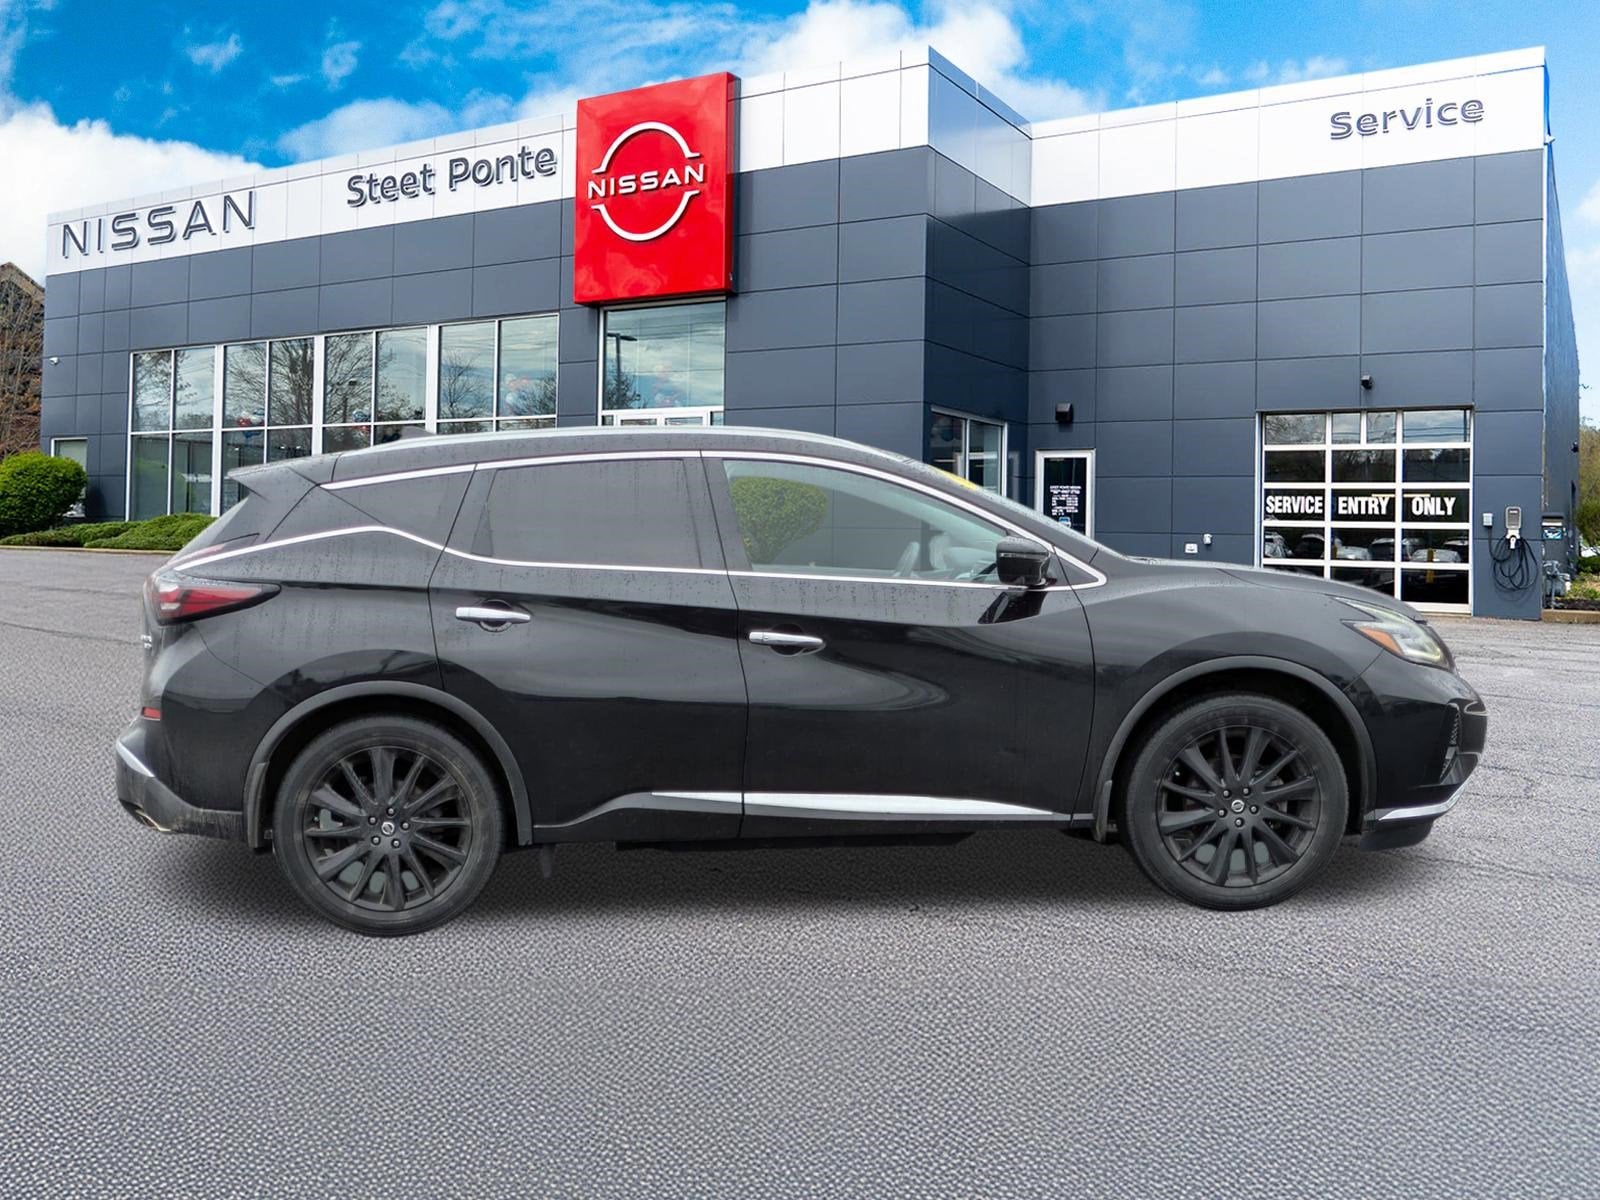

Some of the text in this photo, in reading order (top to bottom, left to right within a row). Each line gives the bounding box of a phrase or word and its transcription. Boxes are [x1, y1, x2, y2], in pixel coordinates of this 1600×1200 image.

[1330, 97, 1485, 140] Service
[347, 145, 558, 208] Steet Ponte
[587, 163, 705, 200] NISSAN
[62, 190, 255, 259] NISSAN
[1265, 495, 1456, 516] SERVICE ENTRY ONLY
